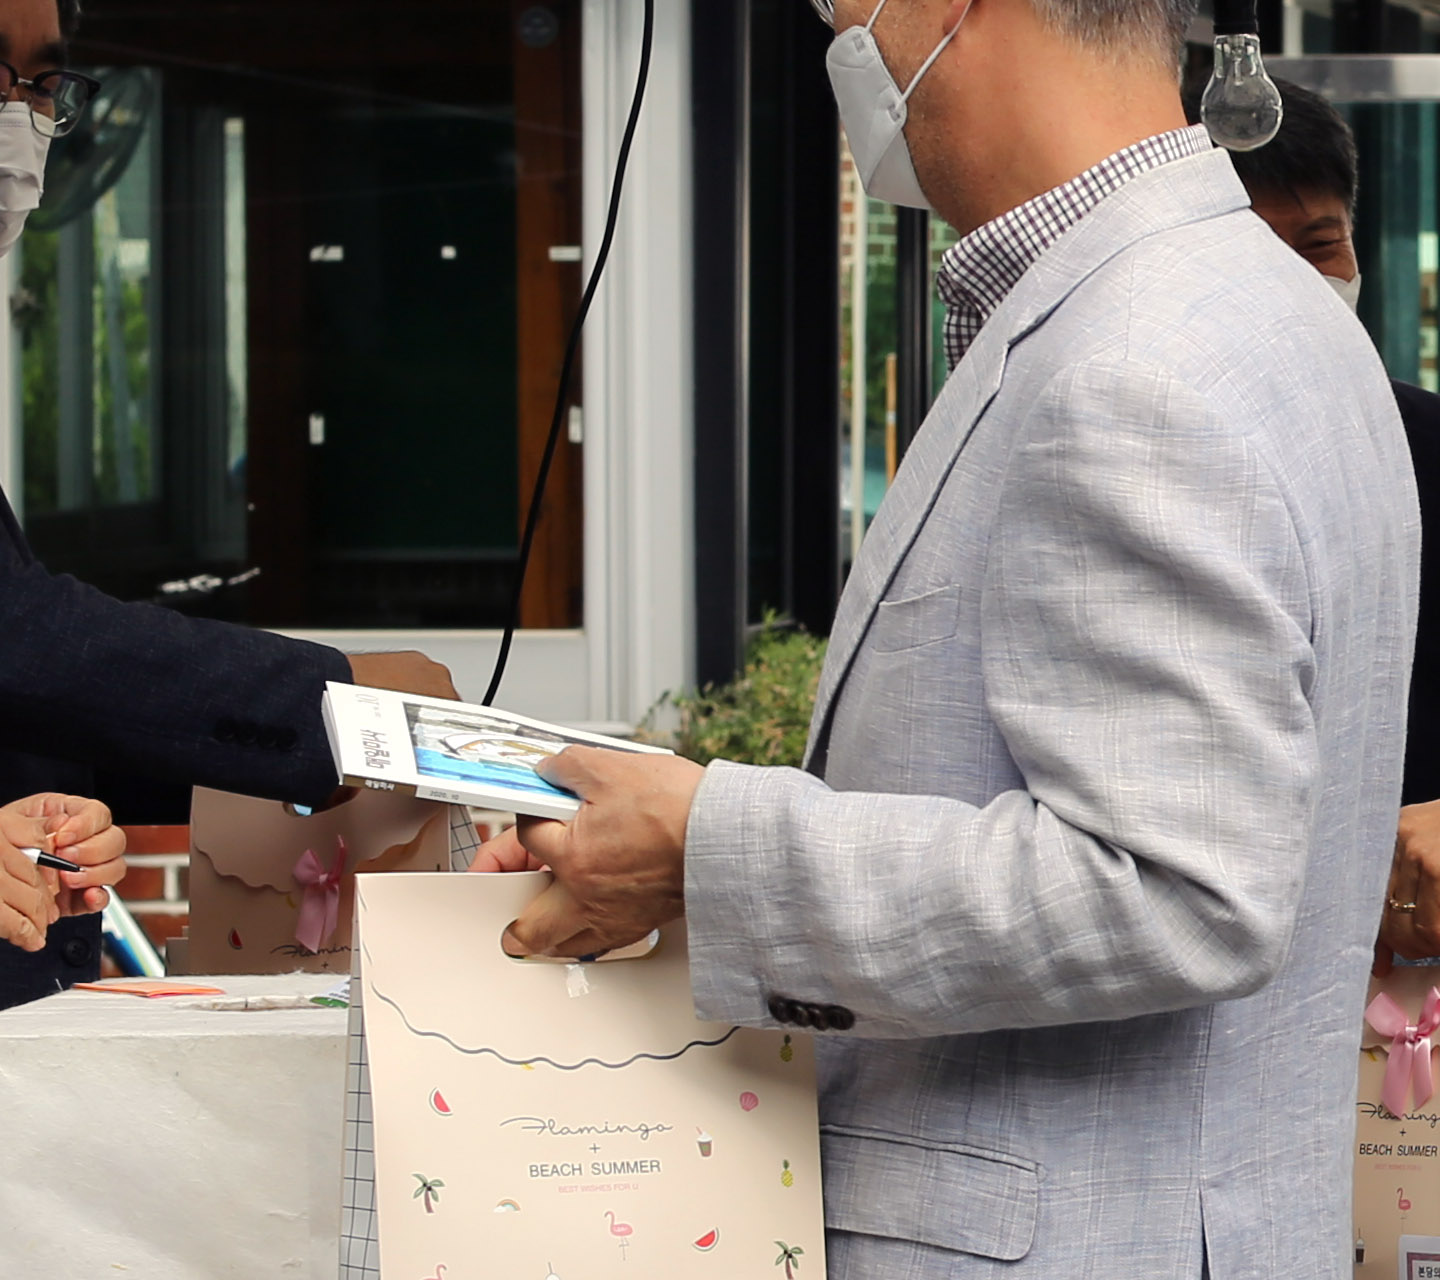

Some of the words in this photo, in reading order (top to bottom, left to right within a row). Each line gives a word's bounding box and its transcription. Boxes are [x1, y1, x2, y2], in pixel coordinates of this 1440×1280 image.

[360, 728, 391, 769] 매일미사
[499, 1116, 674, 1141] Flamingo
[1360, 1143, 1392, 1155] BEACH
[1397, 1144, 1438, 1157] SUMMER
[529, 1163, 583, 1178] BEACH
[591, 1159, 662, 1176] SUMMER
[558, 1185, 580, 1193] BEST
[581, 1184, 612, 1193] WISHES
[613, 1183, 631, 1191] FOR
[1418, 1266, 1440, 1279] 본당의
